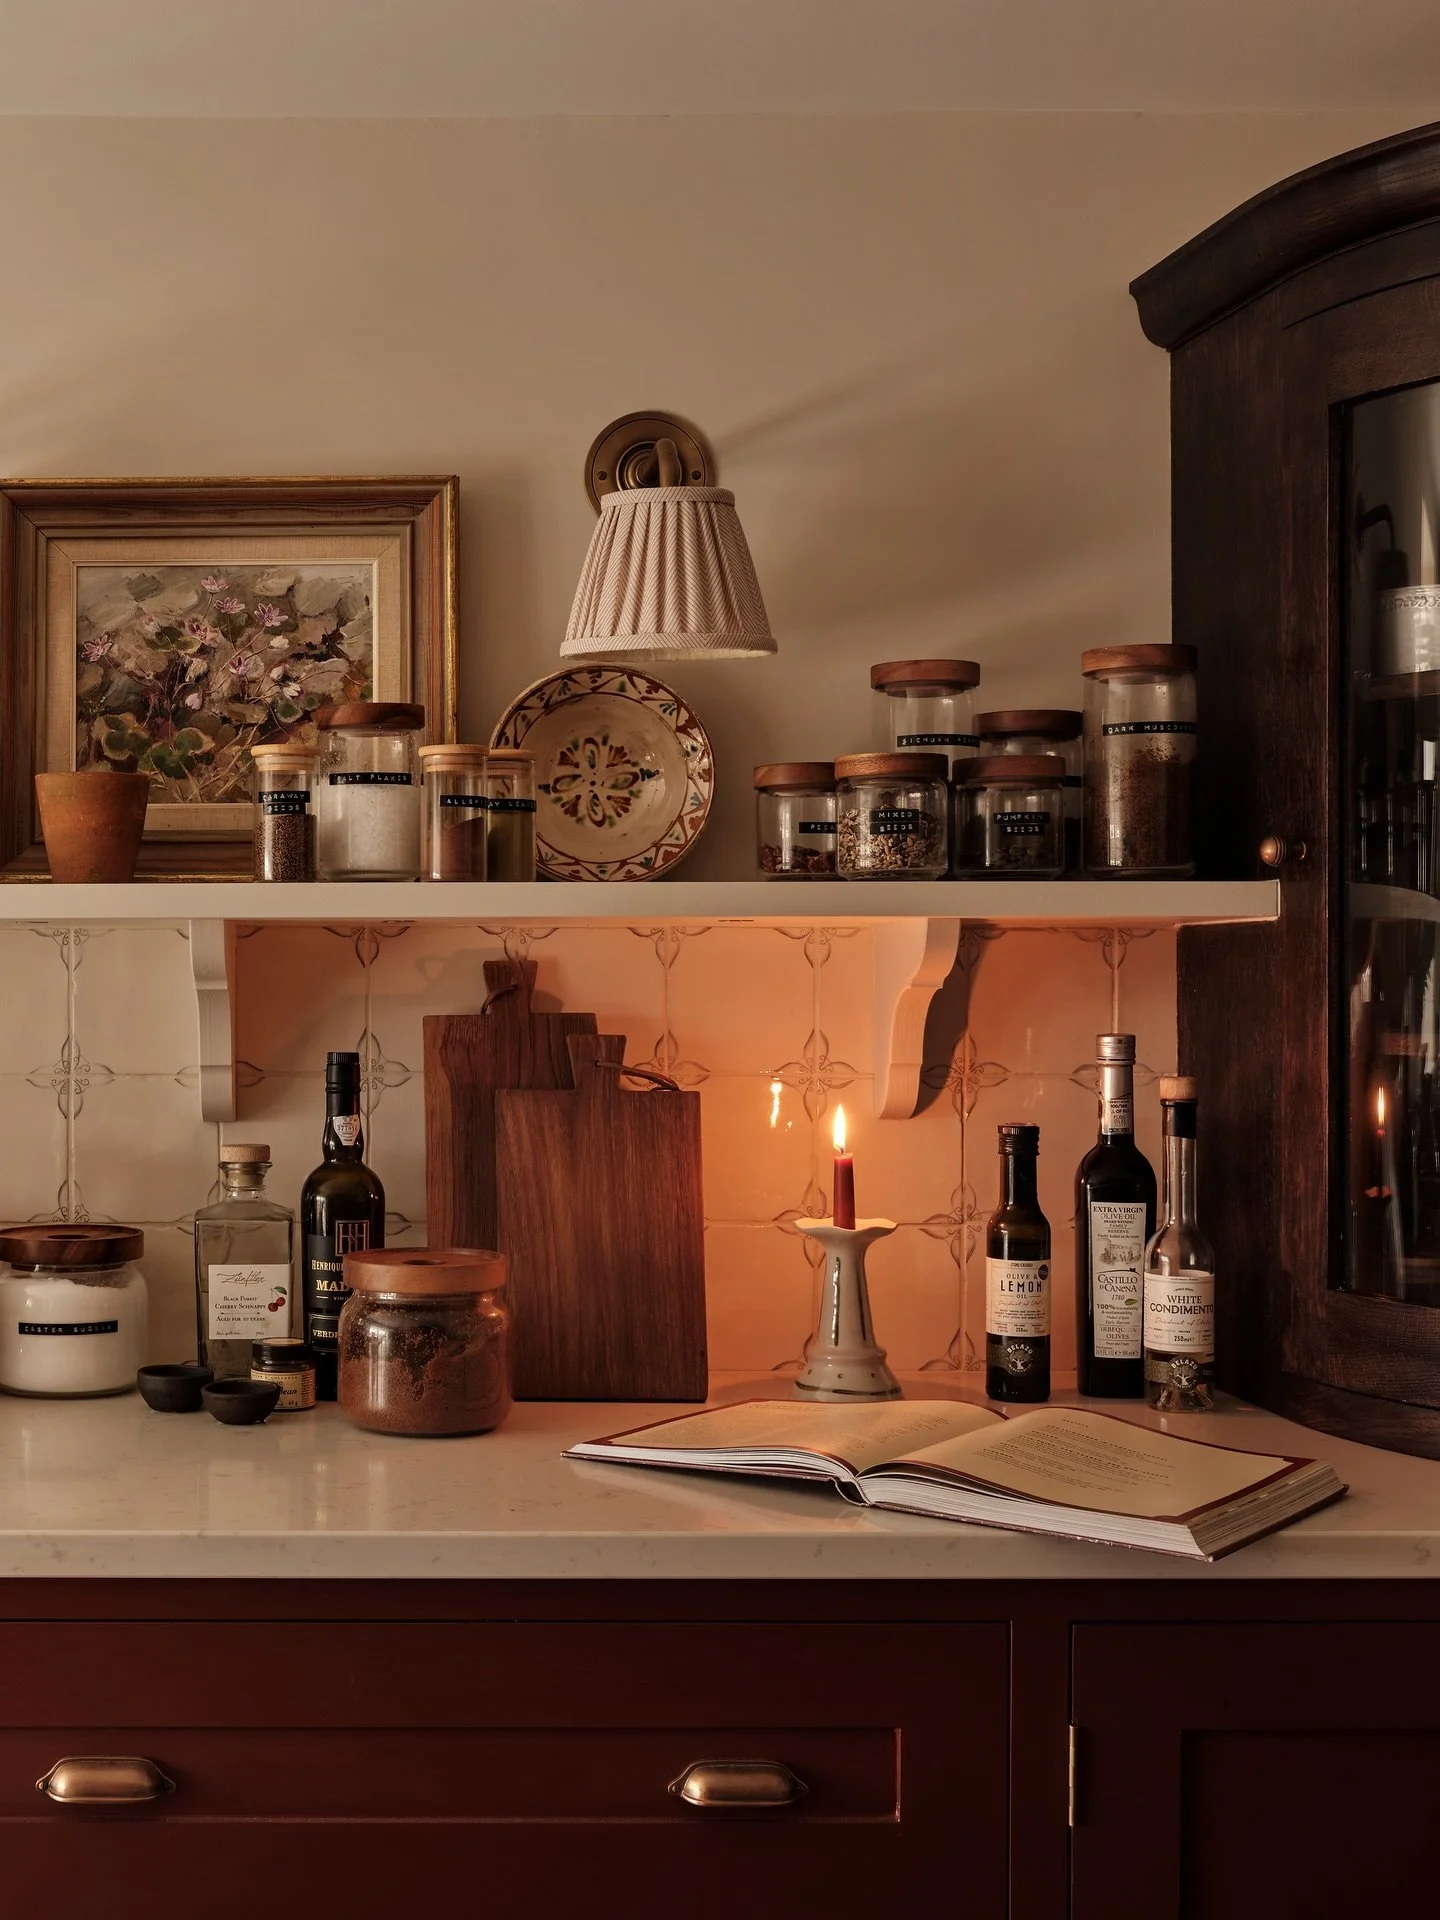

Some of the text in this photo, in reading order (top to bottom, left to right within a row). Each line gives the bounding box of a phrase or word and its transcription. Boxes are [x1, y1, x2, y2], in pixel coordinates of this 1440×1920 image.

[1108, 725, 1135, 735] DARK
[902, 737, 950, 745] SICHUAN
[336, 774, 360, 783] SALT
[262, 793, 305, 801] CARAWAY
[267, 804, 300, 812] SEEDS
[879, 823, 913, 833] SEEDS
[1118, 1206, 1144, 1214] VIRGIN
[1097, 1273, 1138, 1284] CASTILLO
[1000, 1280, 1042, 1293] LEMON
[1166, 1294, 1203, 1304] WHITE
[1149, 1302, 1214, 1315] CONDIMENTO
[1006, 1343, 1034, 1355] BELAZU
[1170, 1358, 1198, 1370] BELAZU
